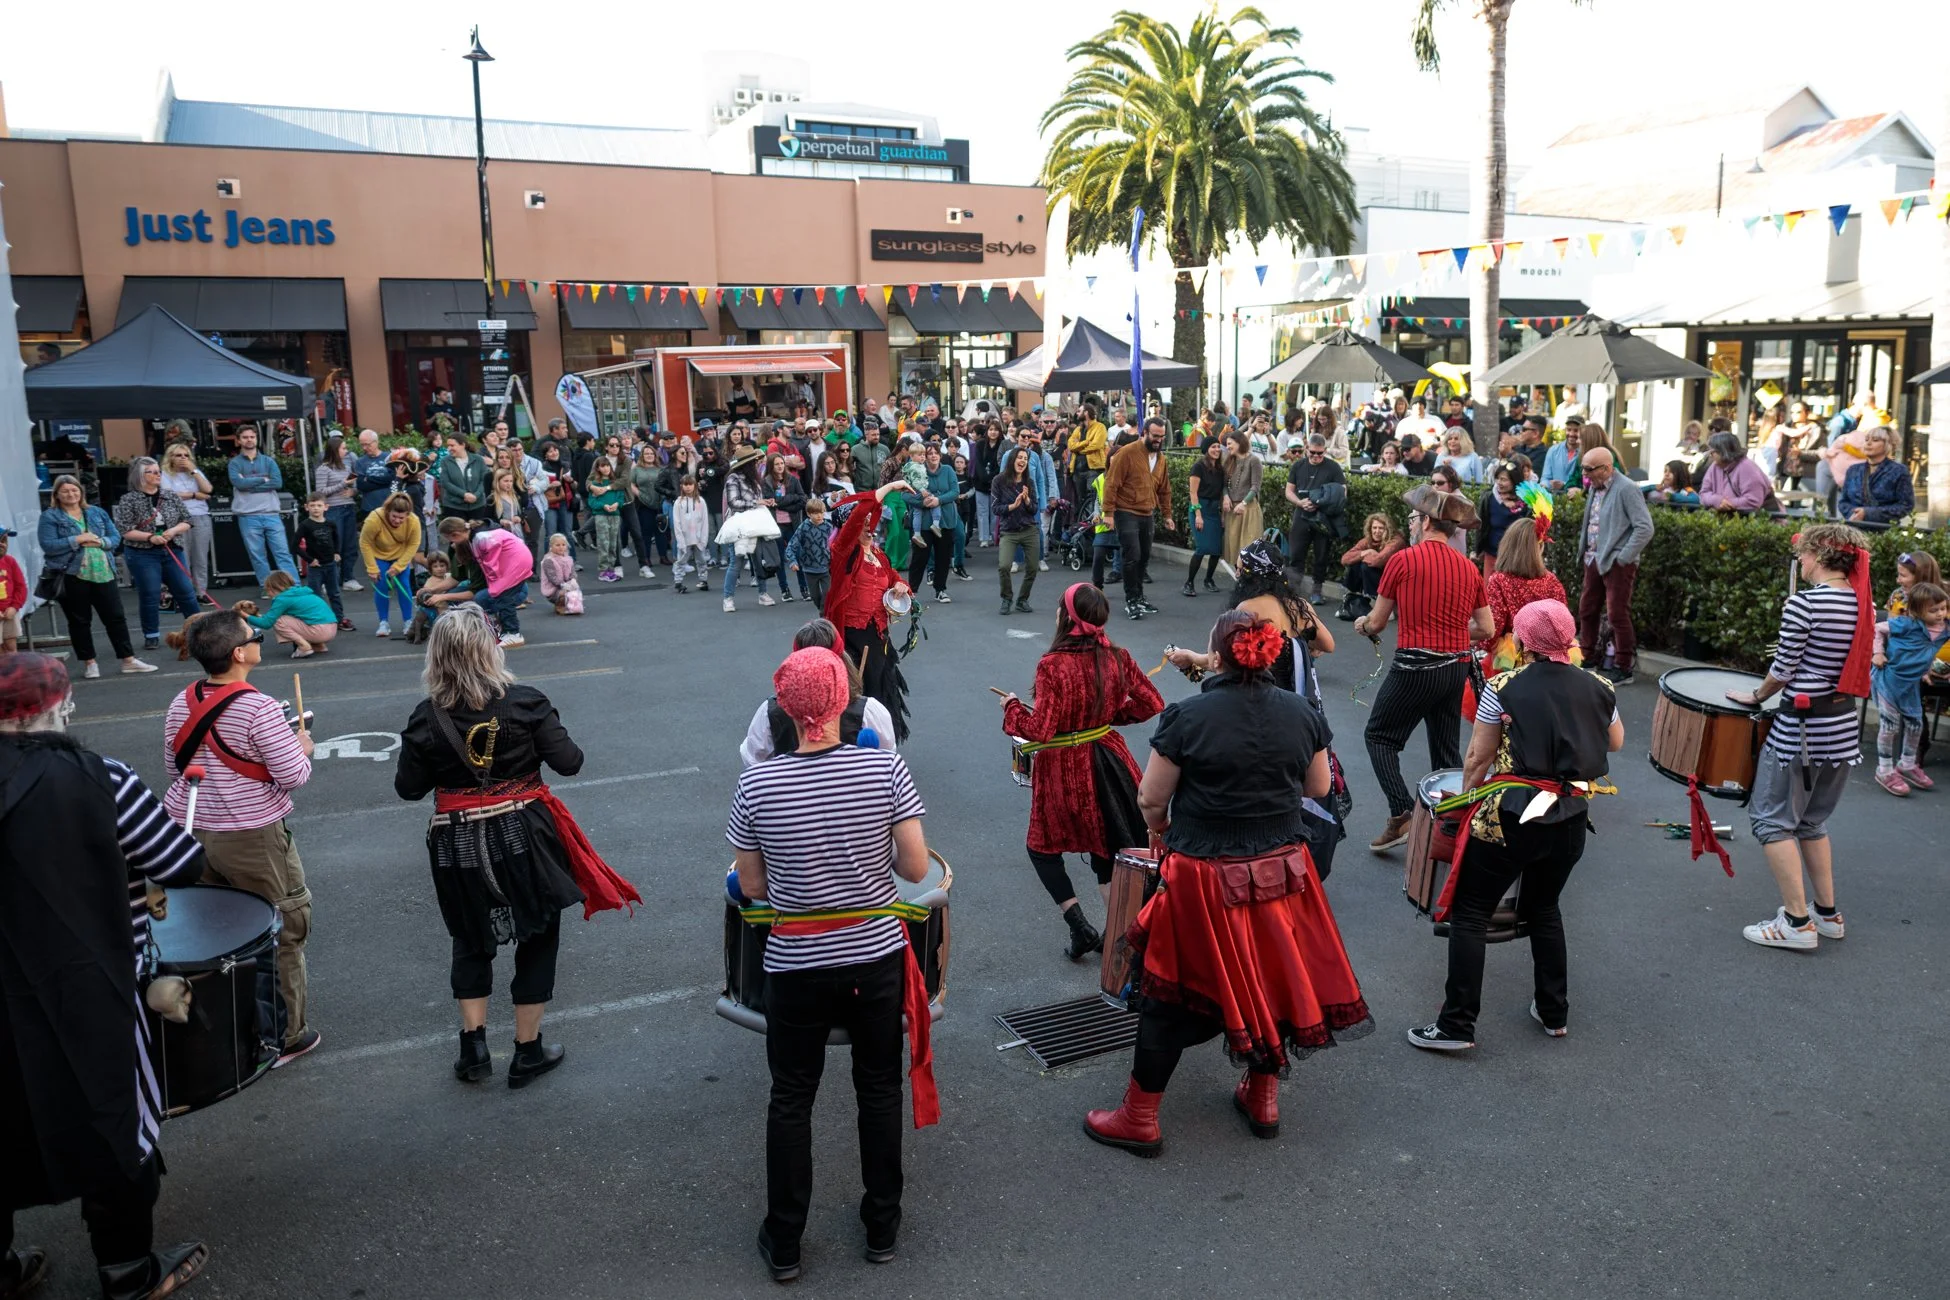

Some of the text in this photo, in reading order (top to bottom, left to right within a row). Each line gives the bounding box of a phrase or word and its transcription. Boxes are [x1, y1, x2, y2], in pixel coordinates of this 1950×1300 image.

[800, 140, 948, 162] perpetual guardian
[124, 206, 335, 248] Just Jeans
[877, 238, 1036, 256] sunglass style
[1520, 267, 1562, 276] moochi
